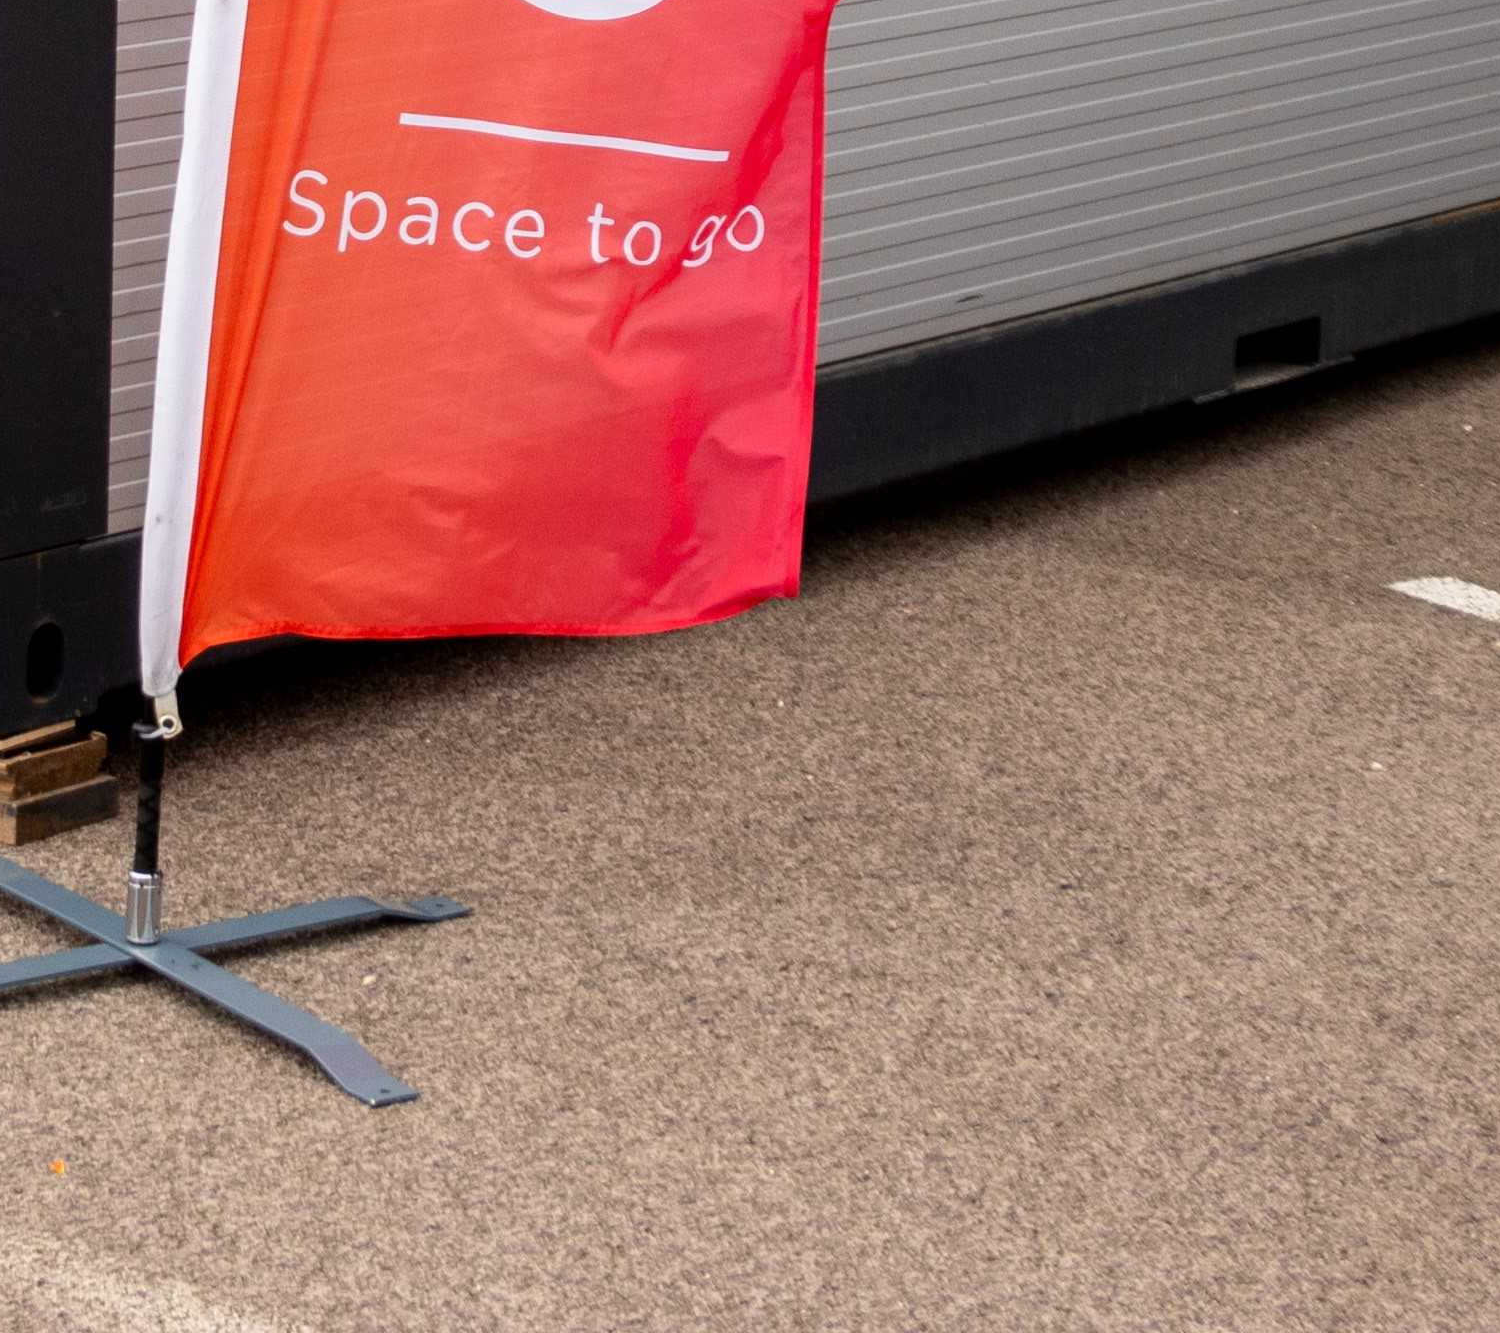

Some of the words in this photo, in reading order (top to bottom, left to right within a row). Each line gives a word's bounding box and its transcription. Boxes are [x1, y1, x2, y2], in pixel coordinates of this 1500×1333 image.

[283, 170, 546, 253] Space
[587, 203, 661, 266] to
[683, 205, 765, 267] go
